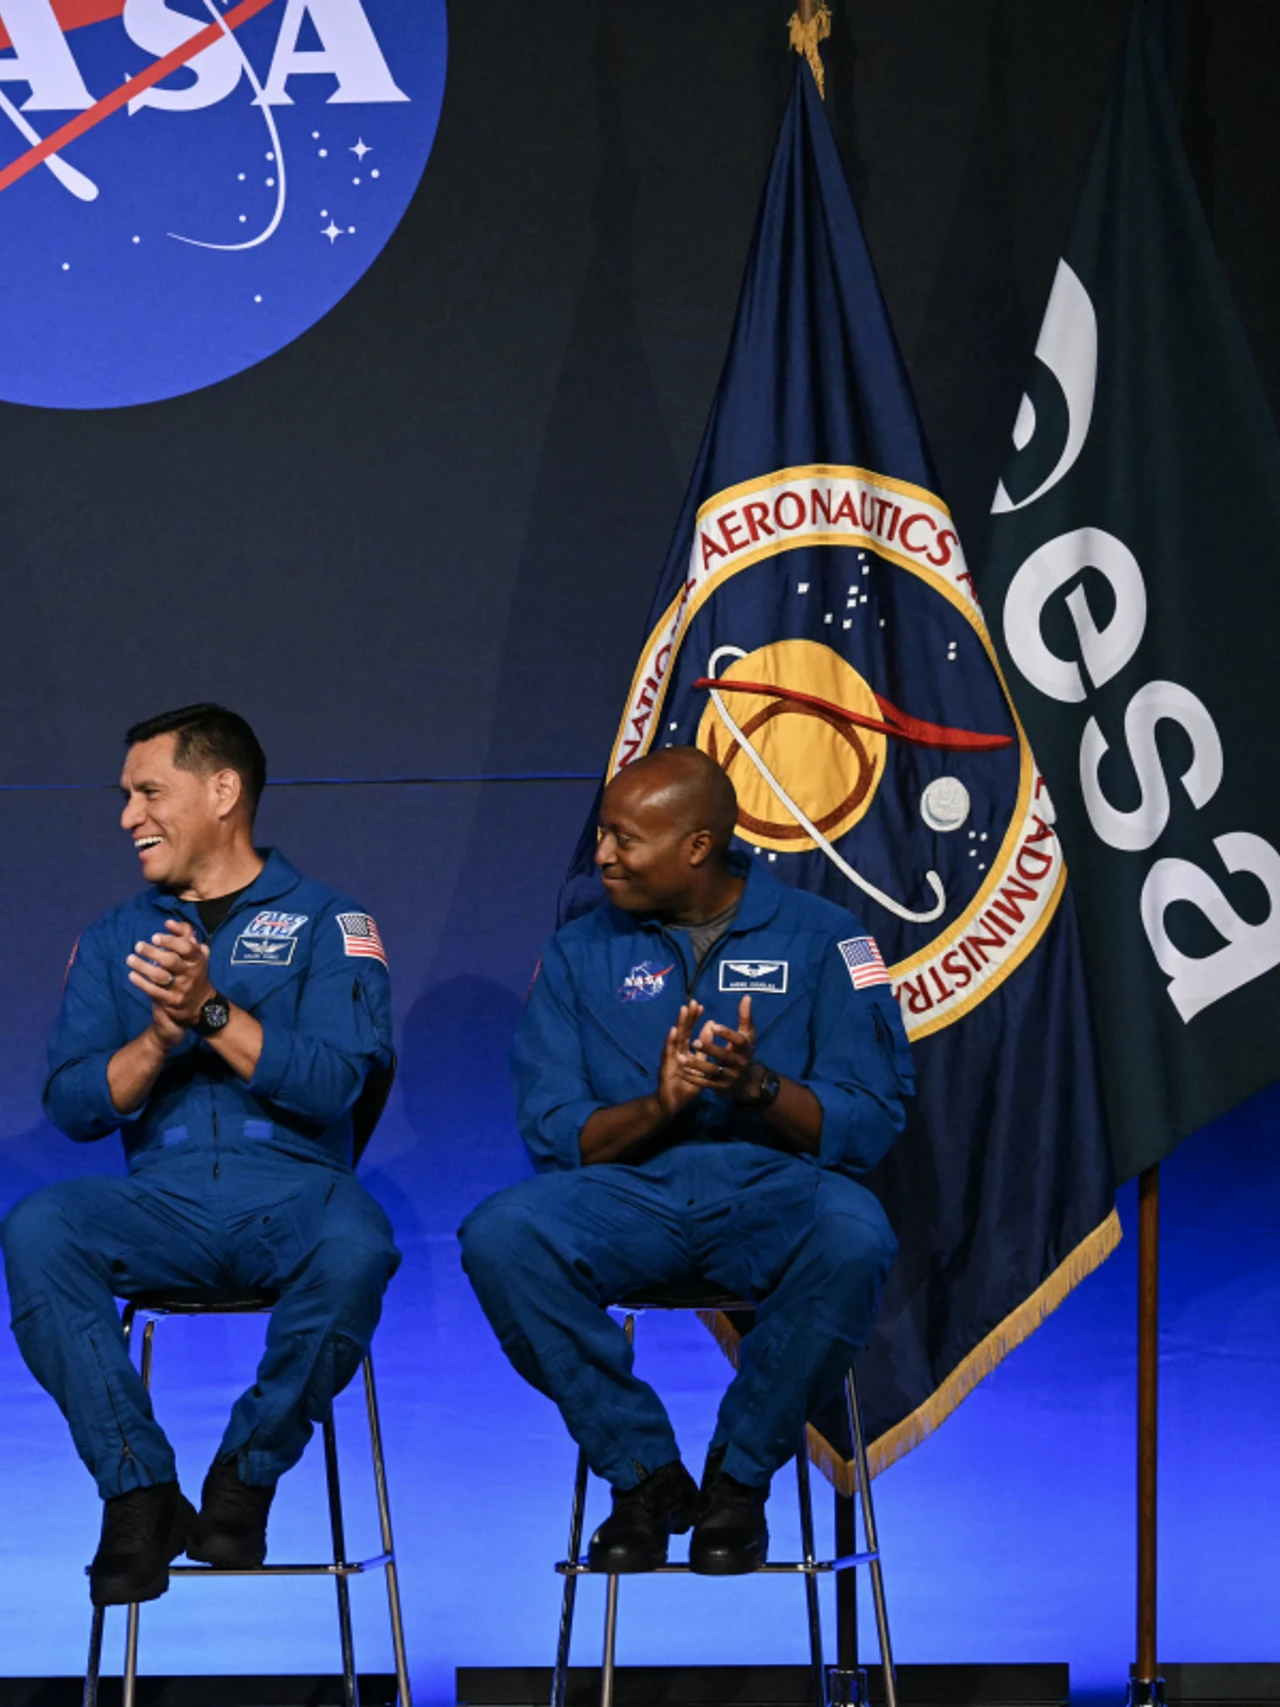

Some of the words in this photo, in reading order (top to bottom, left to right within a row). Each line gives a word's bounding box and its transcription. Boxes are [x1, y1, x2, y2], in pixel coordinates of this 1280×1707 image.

[700, 488, 959, 571] AERONAUTICS
[1003, 526, 1280, 1025] esa
[624, 975, 664, 988] NASA
[893, 814, 1055, 1015] ADMINISTR
